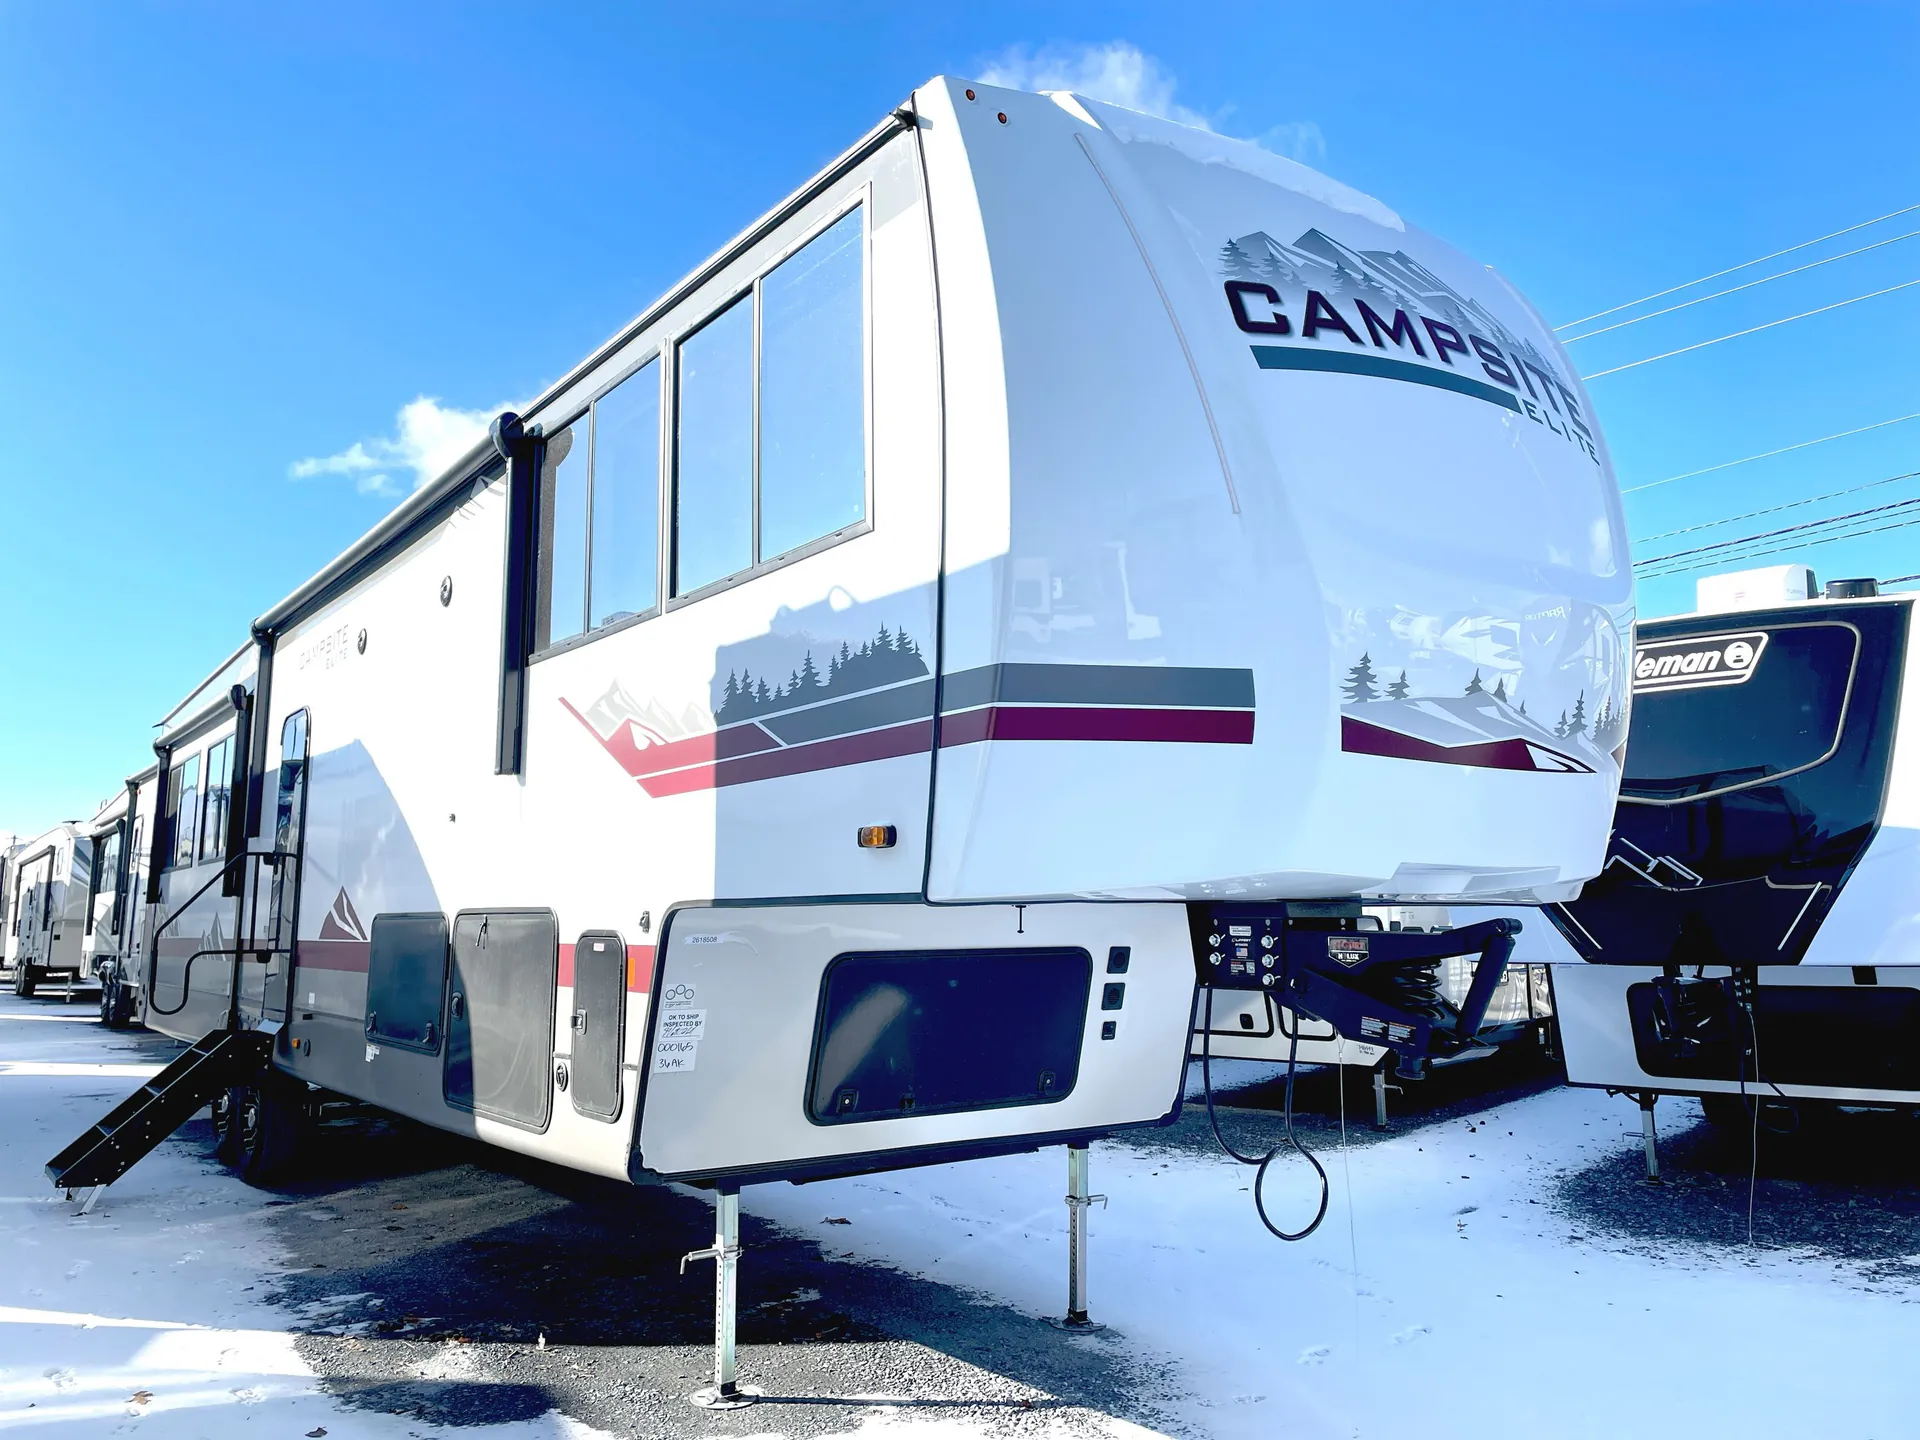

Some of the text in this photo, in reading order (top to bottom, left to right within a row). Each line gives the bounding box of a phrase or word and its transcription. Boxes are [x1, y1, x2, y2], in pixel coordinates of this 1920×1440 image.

[1224, 280, 1593, 442] CAMPSITE
[1522, 399, 1600, 467] ELITE
[300, 624, 348, 670] CAMPSITE
